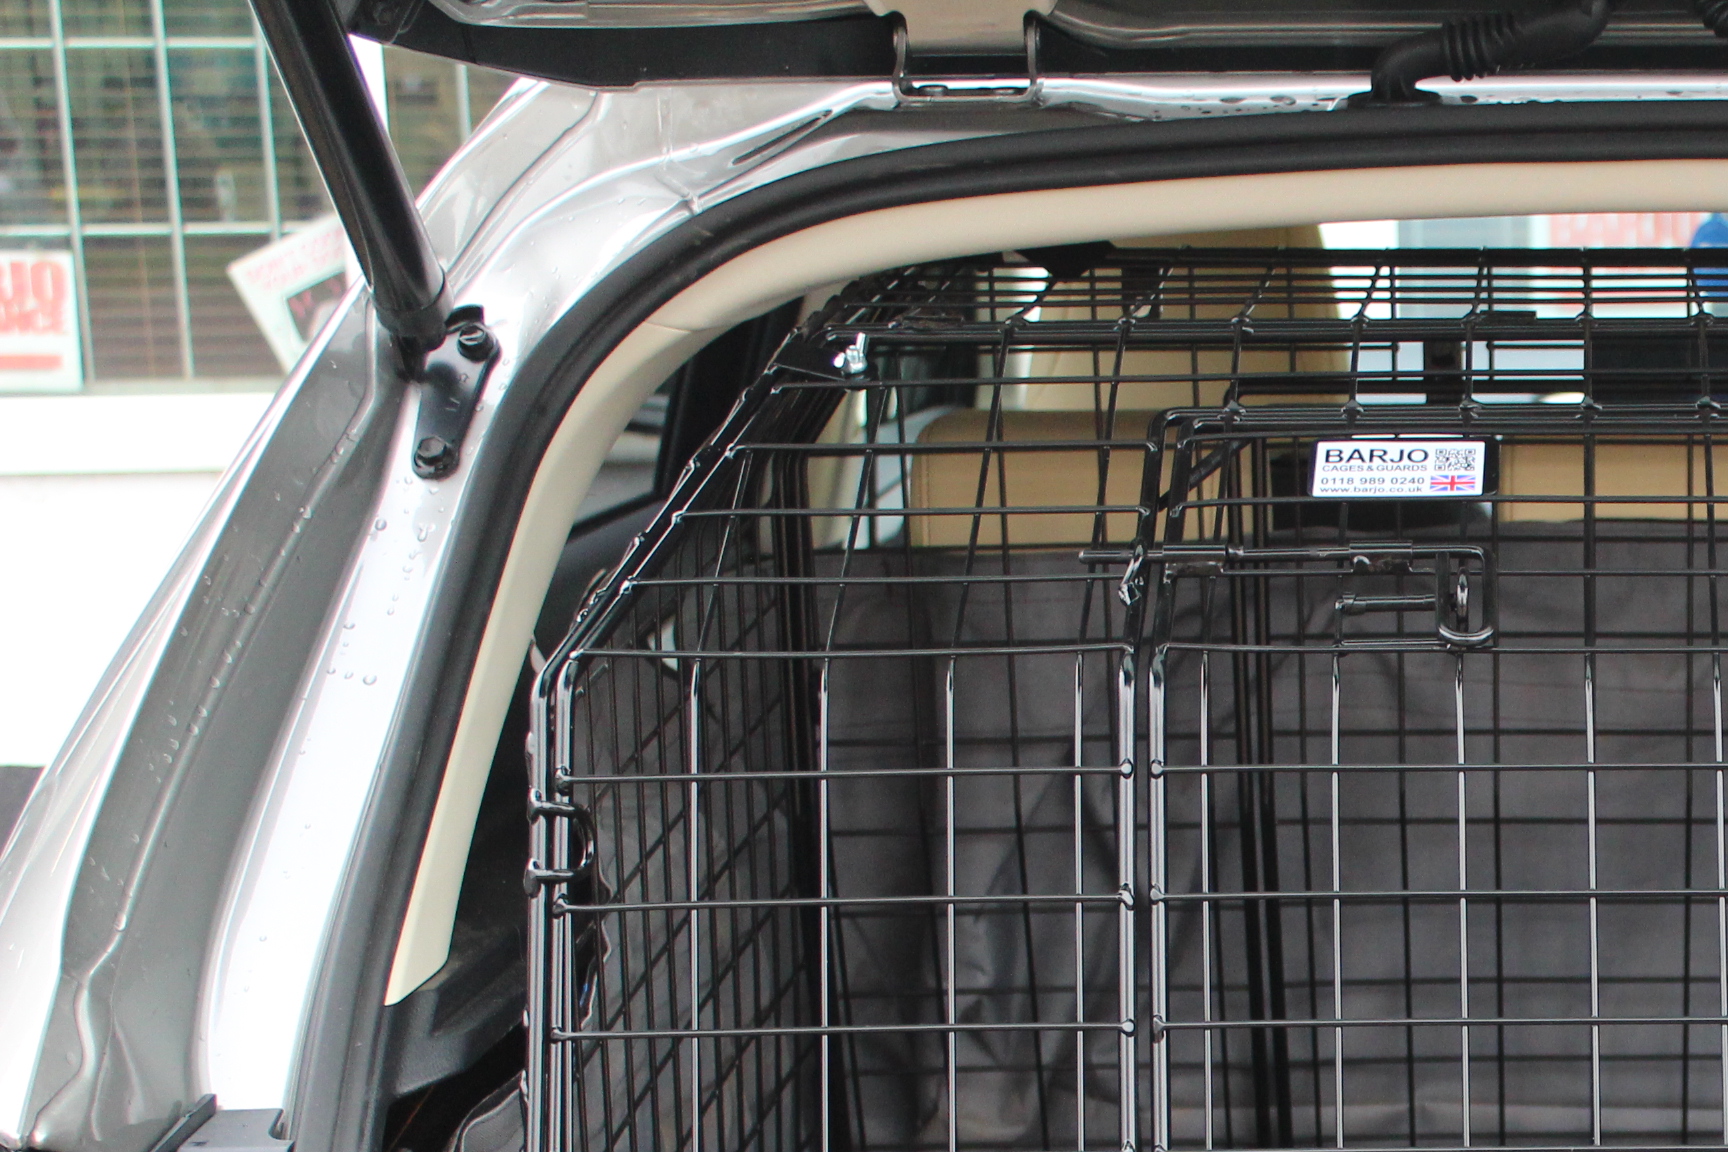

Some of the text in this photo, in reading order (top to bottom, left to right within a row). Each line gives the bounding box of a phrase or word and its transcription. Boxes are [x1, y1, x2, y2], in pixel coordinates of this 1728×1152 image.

[1325, 448, 1430, 464] BARJO
[1322, 464, 1428, 472] CAGES & GUARDS
[1321, 477, 1425, 485] 0118 989 0240
[1320, 486, 1423, 494] www.barjo.co.uk
